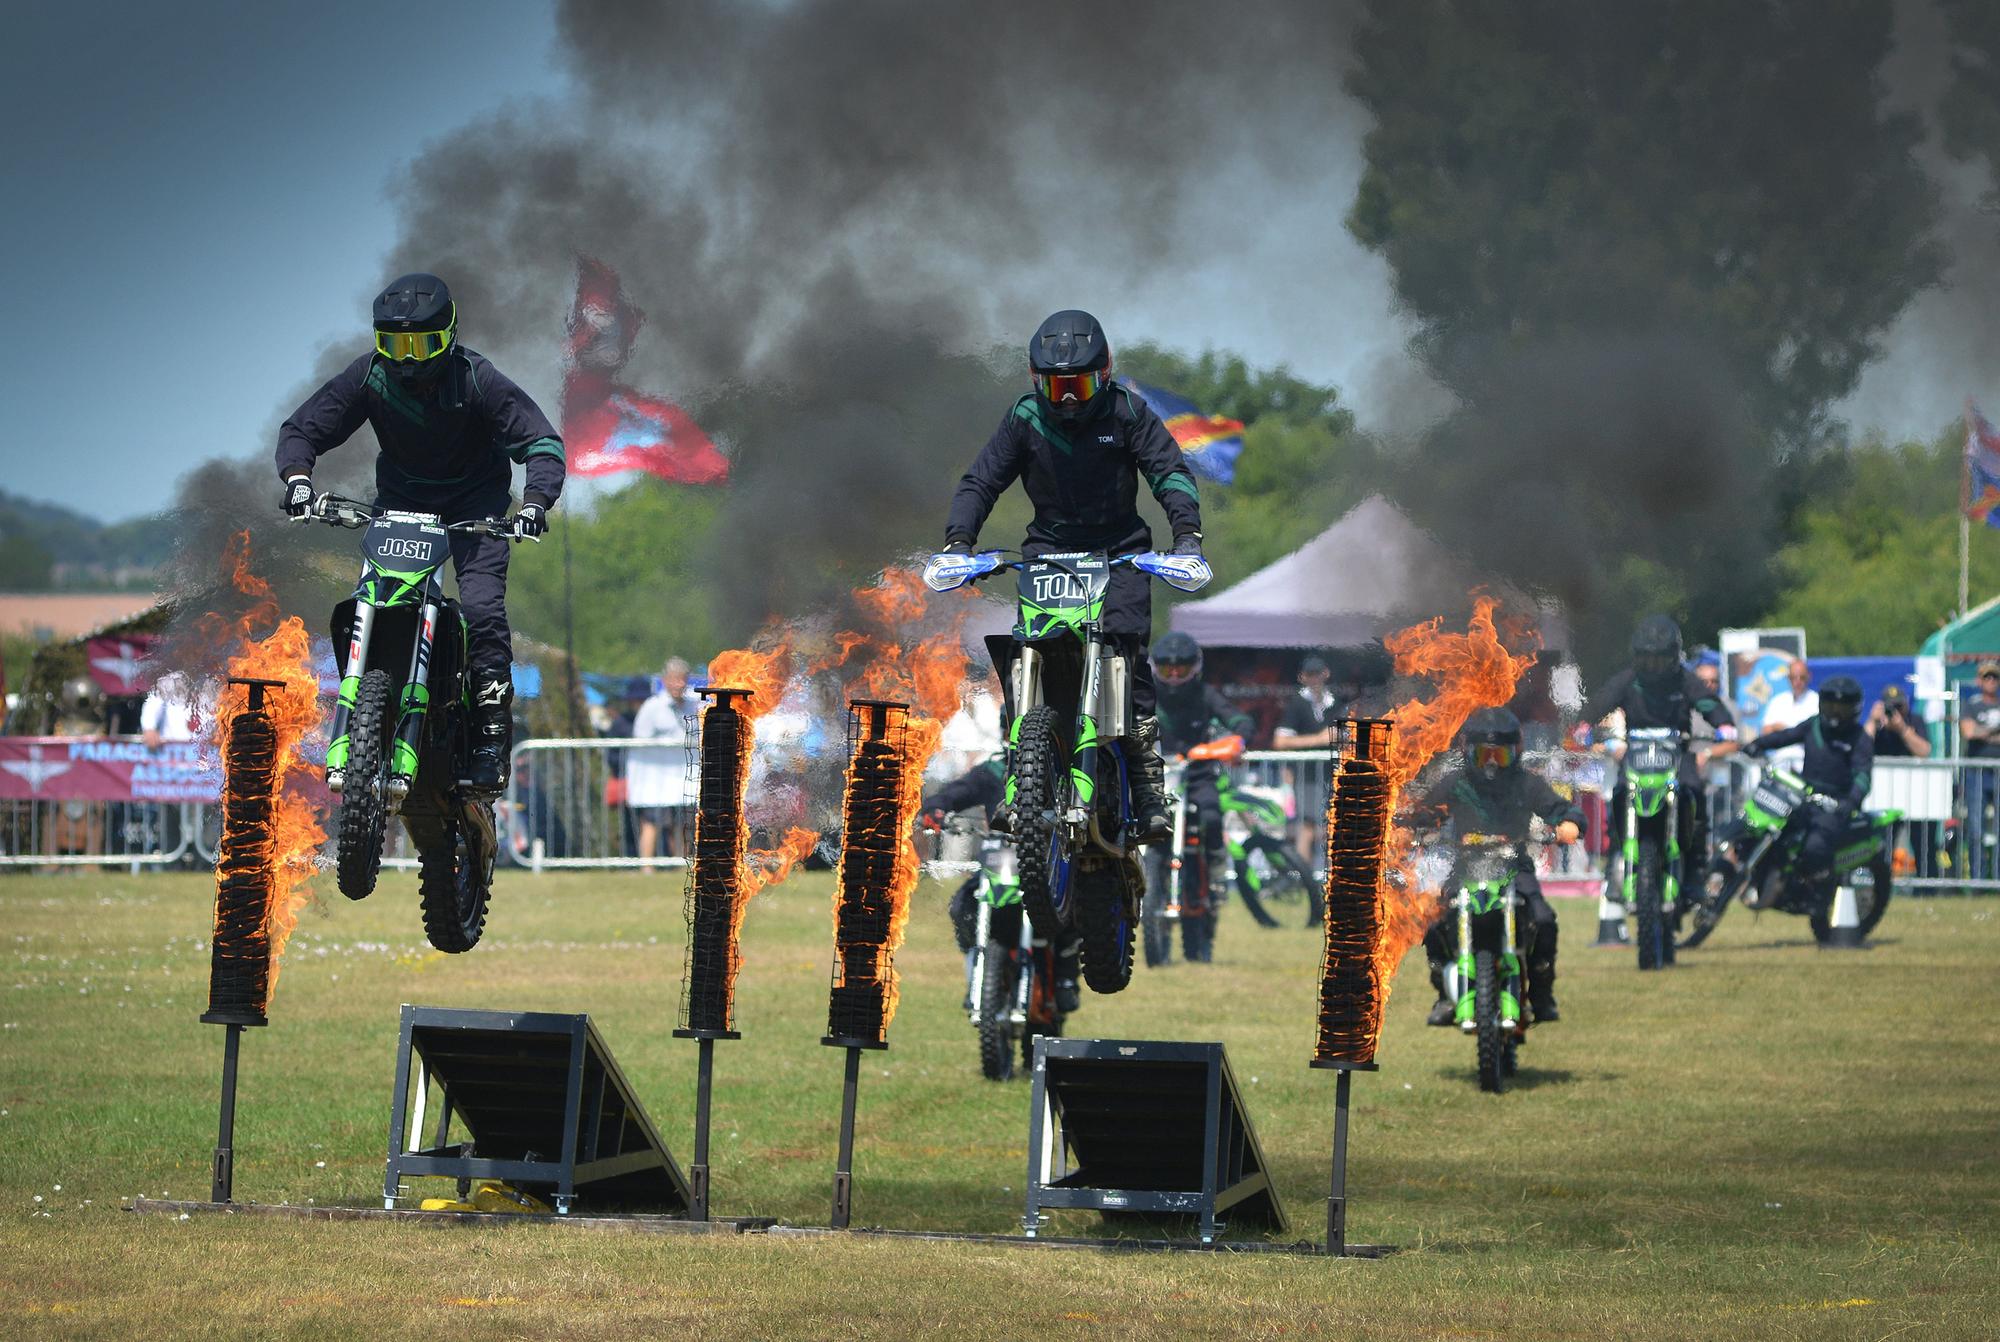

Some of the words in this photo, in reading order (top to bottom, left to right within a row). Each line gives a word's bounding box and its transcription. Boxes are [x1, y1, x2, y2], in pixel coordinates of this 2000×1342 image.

[1097, 435, 1113, 443] TOM
[377, 537, 432, 561] JOSH
[1033, 572, 1092, 602] TOM
